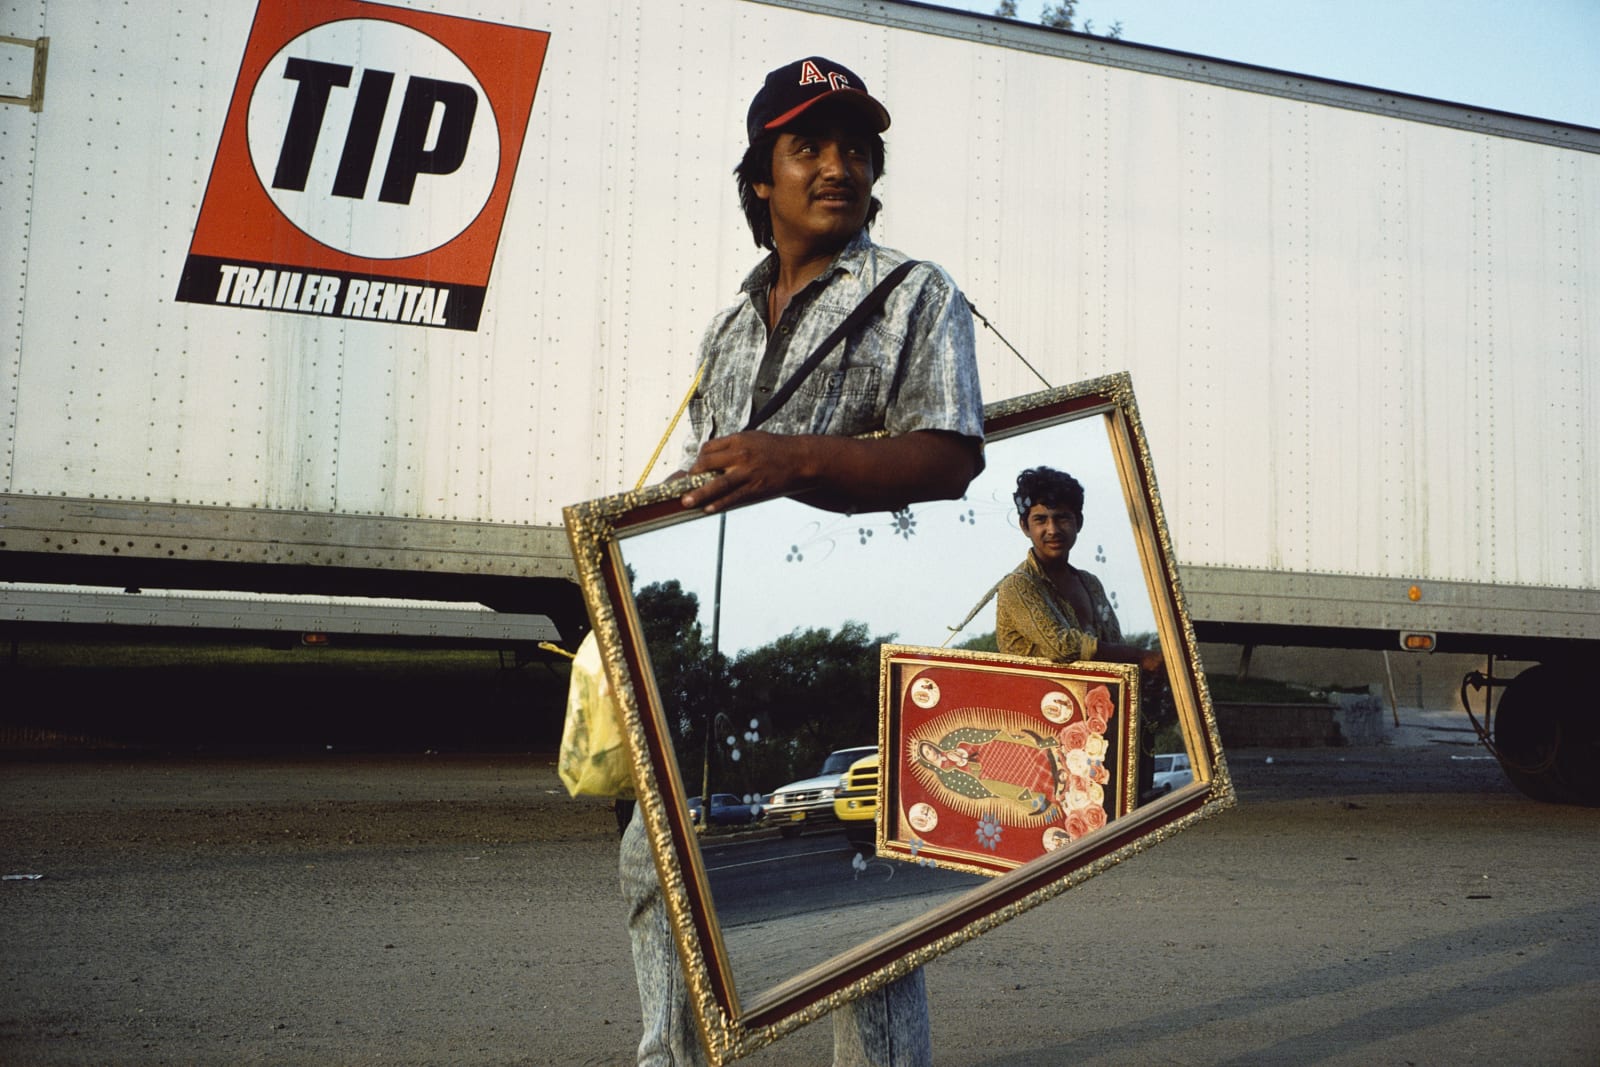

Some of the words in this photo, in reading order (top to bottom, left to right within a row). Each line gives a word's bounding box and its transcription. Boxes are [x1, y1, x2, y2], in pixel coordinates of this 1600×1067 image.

[271, 57, 479, 206] TIP
[215, 264, 341, 315] TRAILER
[341, 278, 450, 326] RENTAL
